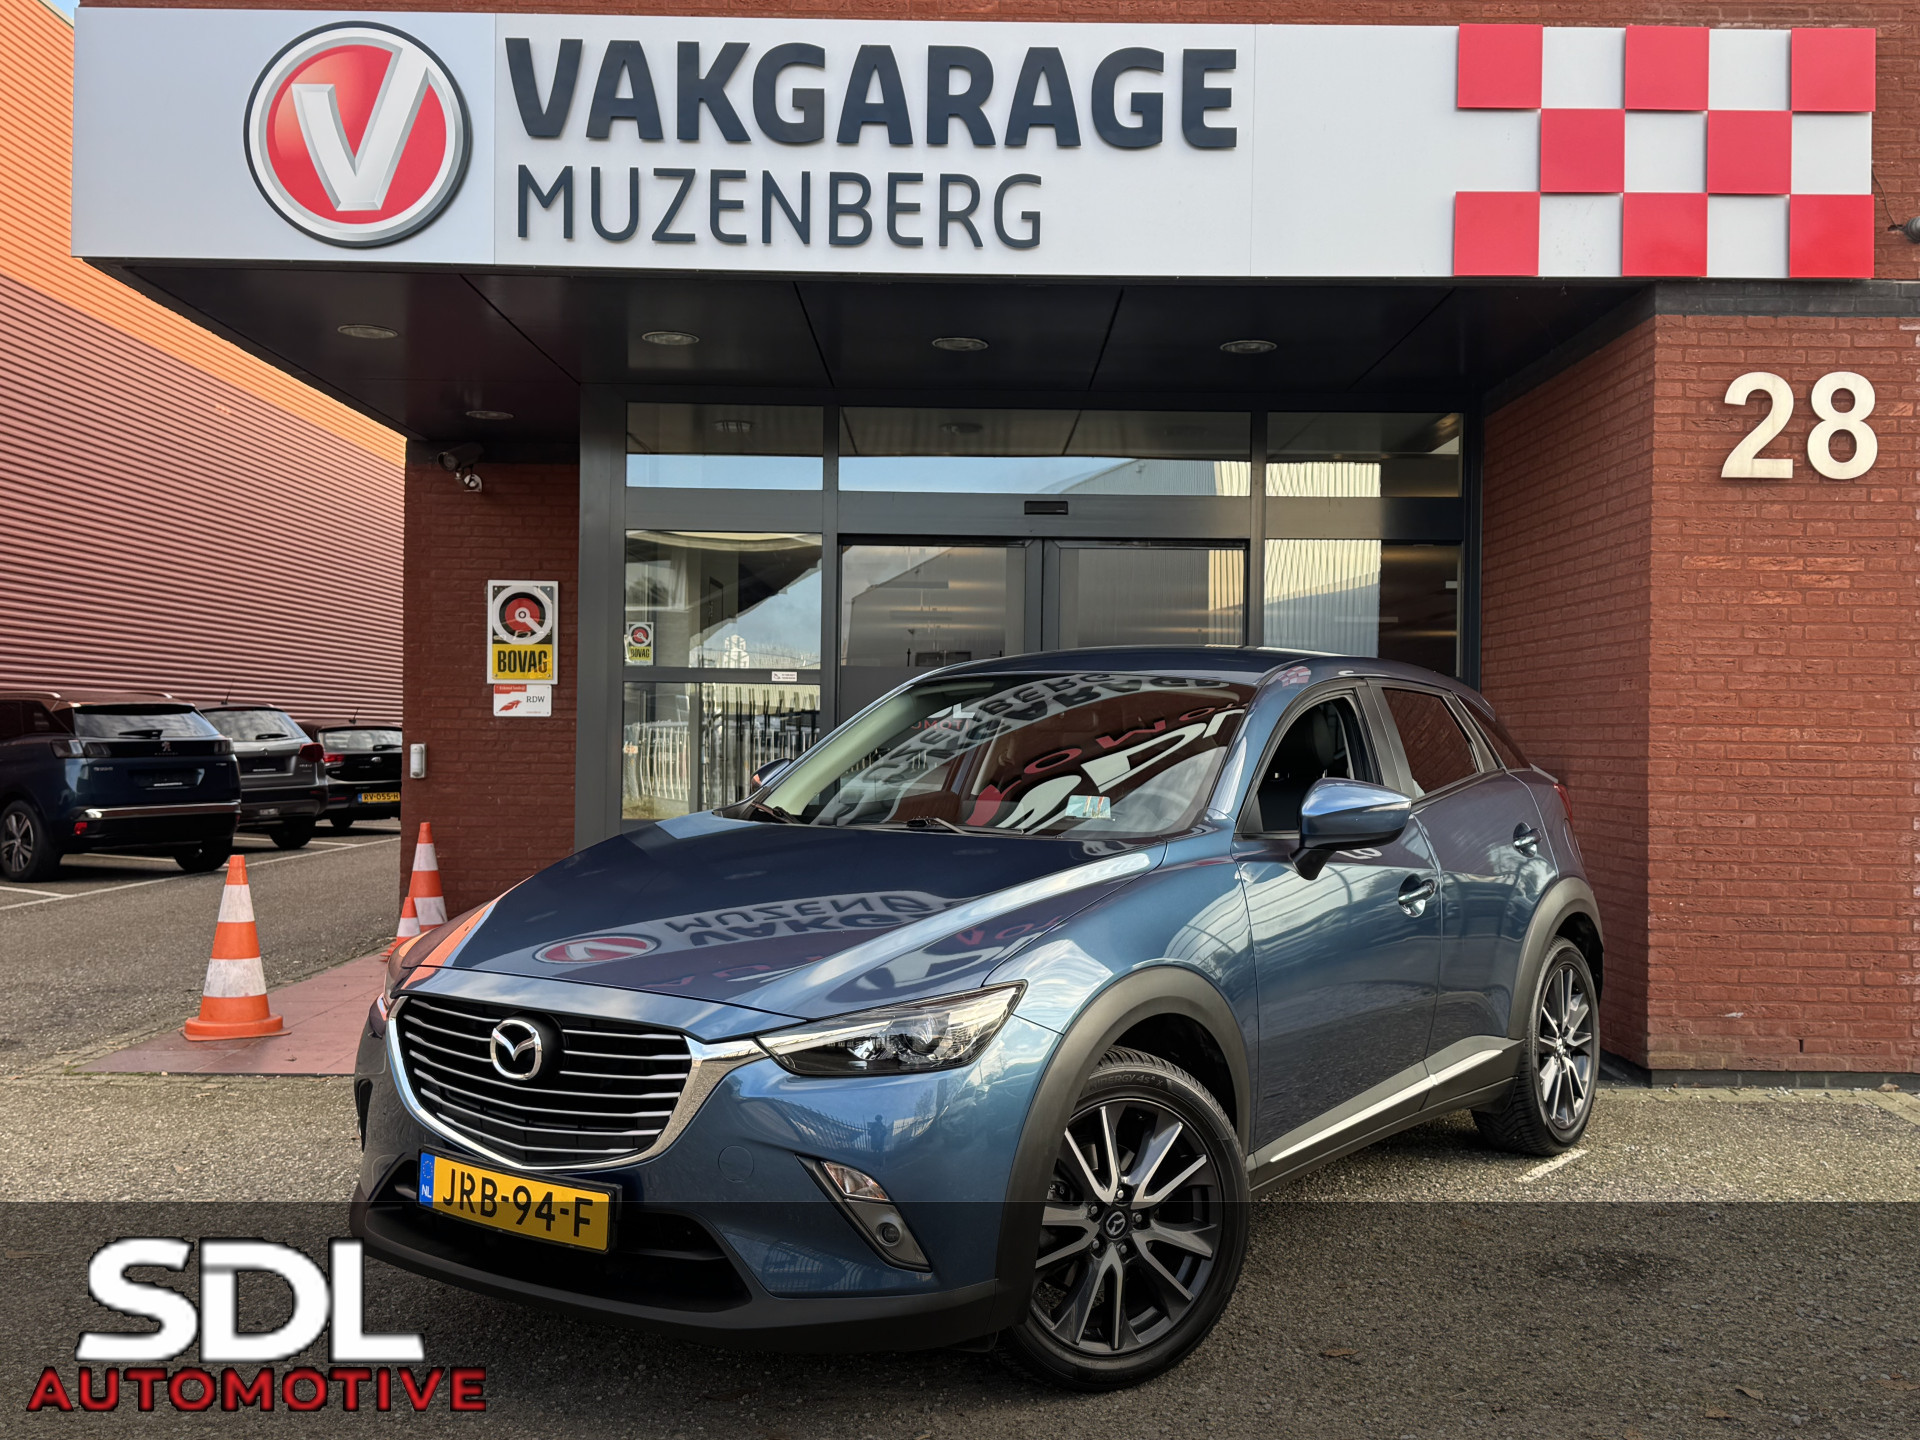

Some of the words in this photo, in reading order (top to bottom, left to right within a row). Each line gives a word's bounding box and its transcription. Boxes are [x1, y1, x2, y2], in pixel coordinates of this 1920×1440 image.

[504, 37, 1238, 149] VAKGARAGE
[517, 163, 1042, 249] MUZENBERG
[1720, 371, 1878, 480] 28
[497, 649, 548, 674] BOVAG
[630, 648, 650, 658] BOVAG
[526, 695, 545, 703] RDW
[363, 793, 400, 802] RV-055-H
[421, 1183, 432, 1199] NL
[442, 1168, 594, 1238] JRB-94-F
